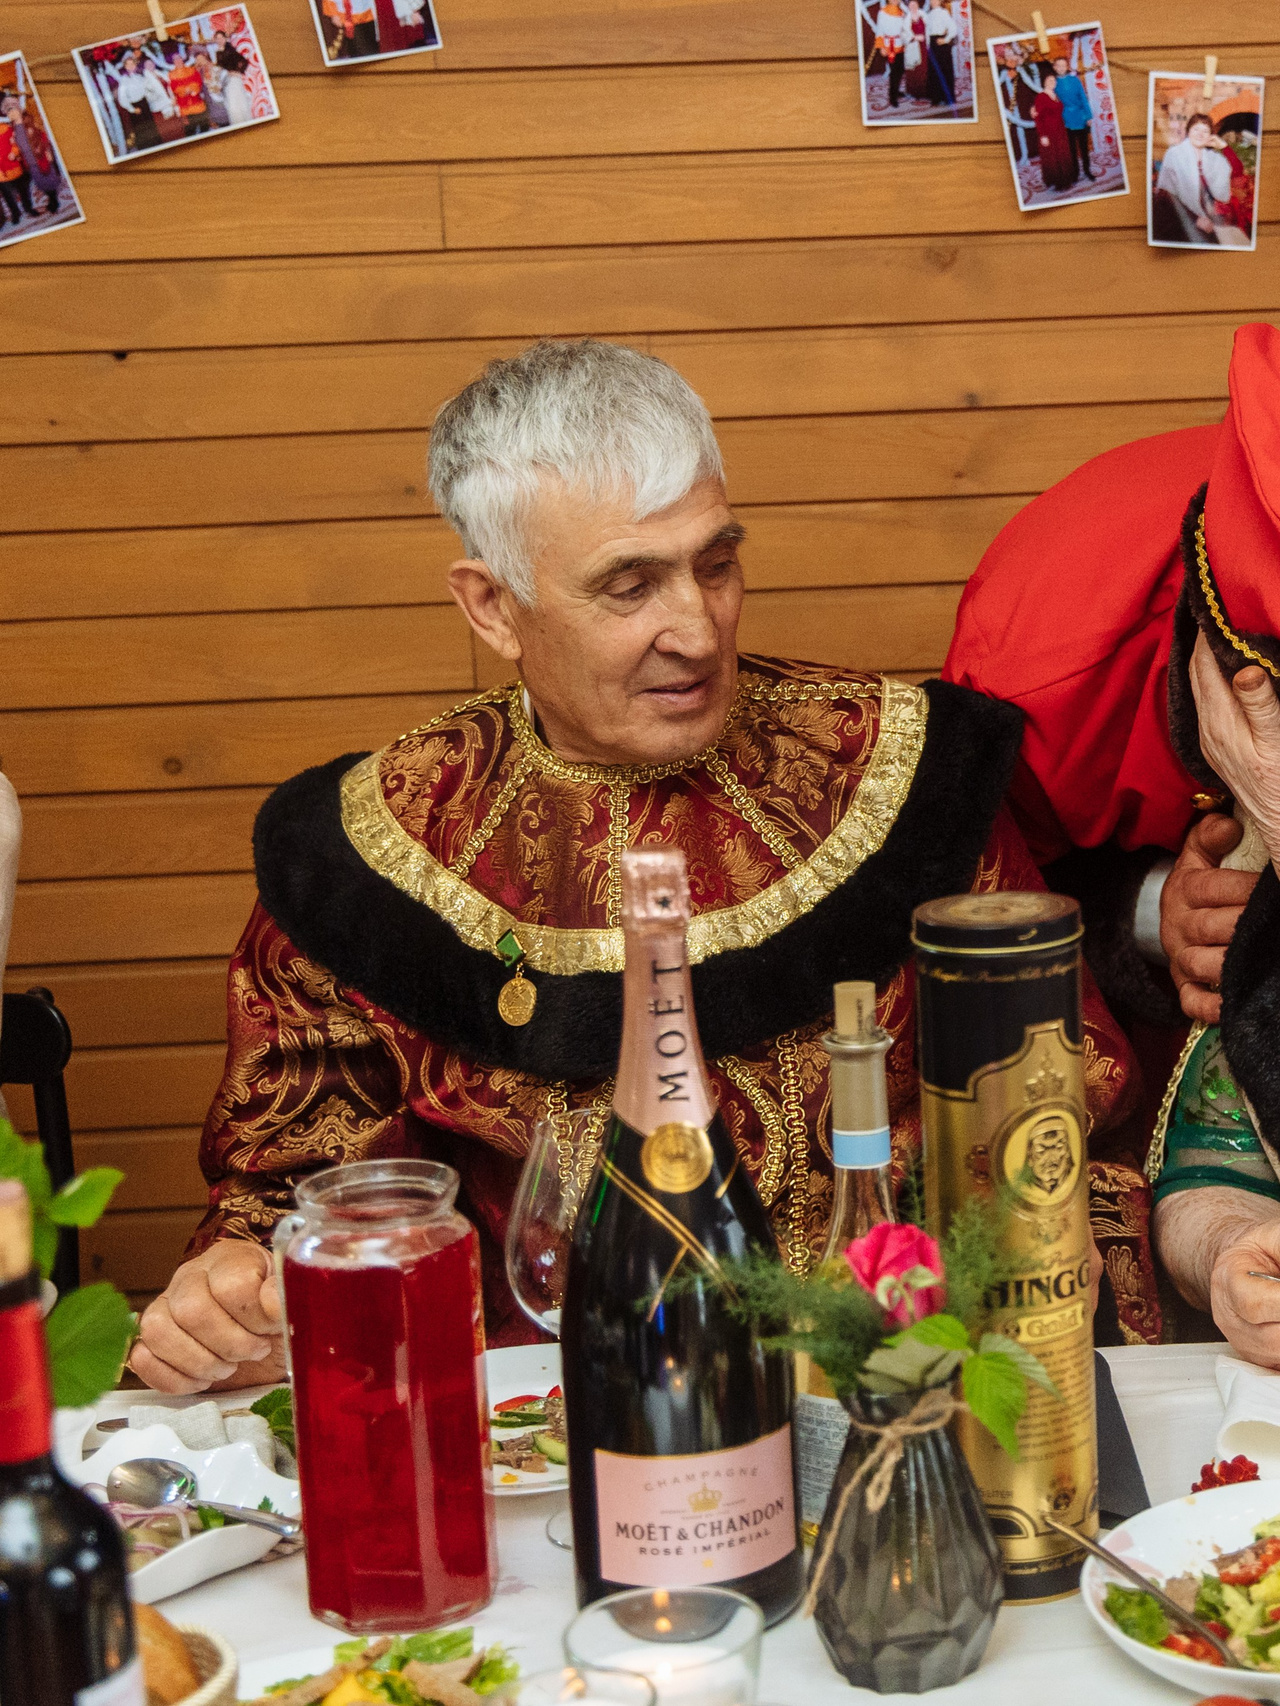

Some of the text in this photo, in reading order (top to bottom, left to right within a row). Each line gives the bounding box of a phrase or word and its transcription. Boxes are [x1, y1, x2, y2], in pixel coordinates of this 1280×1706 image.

[648, 959, 691, 1102] MOËT
[644, 1466, 759, 1492] CHAMPAGNE
[615, 1521, 671, 1542] MOËT
[676, 1528, 689, 1541] &
[693, 1497, 785, 1539] CHANDON
[639, 1529, 771, 1556] ROSÉ IMPÉRIAL
